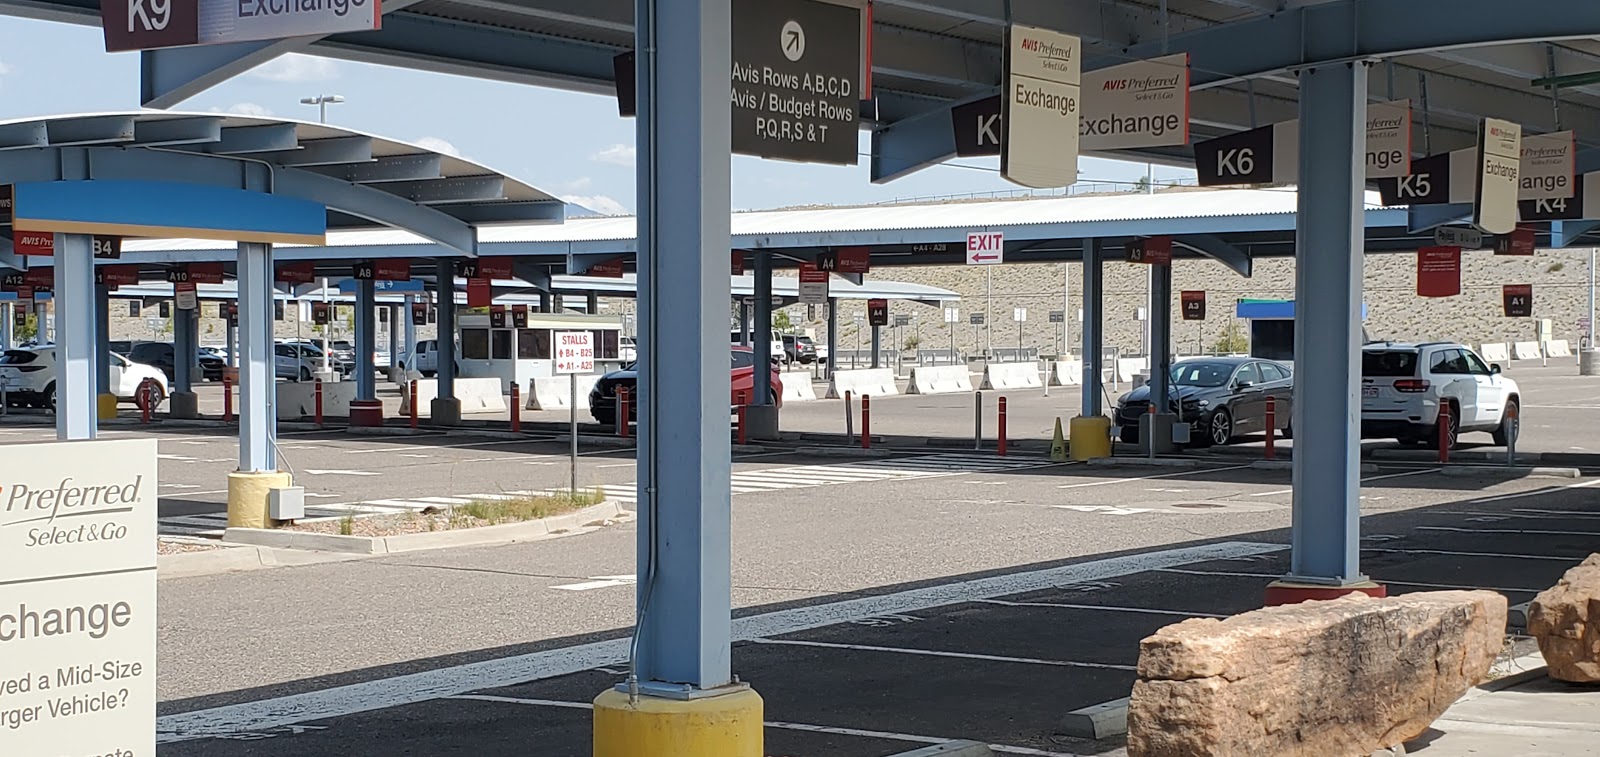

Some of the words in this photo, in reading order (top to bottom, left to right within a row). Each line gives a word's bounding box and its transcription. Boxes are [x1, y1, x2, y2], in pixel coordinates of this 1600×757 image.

[128, 0, 172, 32] K9
[1021, 38, 1038, 52] AVIS
[1038, 41, 1071, 60] Preferred
[732, 62, 760, 84] Avis
[763, 67, 799, 90] Rows
[803, 73, 851, 99] A,B,C,D
[1102, 79, 1127, 91] AVIS
[1127, 74, 1180, 93] Preferred
[730, 87, 757, 110] Avis
[769, 93, 816, 119] Budget
[819, 101, 853, 122] Rows
[1016, 84, 1076, 116] Exchange
[756, 117, 803, 143] P,Q,R,S
[807, 124, 816, 142] &
[819, 125, 828, 143] T
[977, 114, 1001, 146] K
[1525, 146, 1567, 158] Preferred
[1216, 148, 1254, 177] K6
[1486, 160, 1517, 181] Exchange
[1397, 173, 1431, 198] K5
[1518, 175, 1567, 192] ange
[1535, 198, 1567, 213] K4
[21, 236, 40, 245] AVIS
[968, 234, 1002, 251] EXIT
[1499, 240, 1508, 252] A1
[1131, 248, 1141, 260] A3
[463, 266, 475, 276] A7
[823, 258, 834, 269] A4
[5, 276, 23, 284] A12
[170, 272, 187, 281] A10
[359, 268, 371, 277] A8
[1188, 302, 1200, 310] A3
[1512, 297, 1524, 305] A1
[562, 335, 588, 345] STALLS
[565, 349, 574, 357] B4
[580, 349, 592, 357] B25
[566, 362, 574, 370] A1
[581, 361, 592, 370] A25
[6, 475, 142, 524] Preferred
[25, 522, 127, 547] Select&Go
[38, 675, 50, 690] a
[57, 660, 143, 688] Mid-Size
[0, 705, 42, 729] rger
[47, 688, 129, 718] Vehicle?
